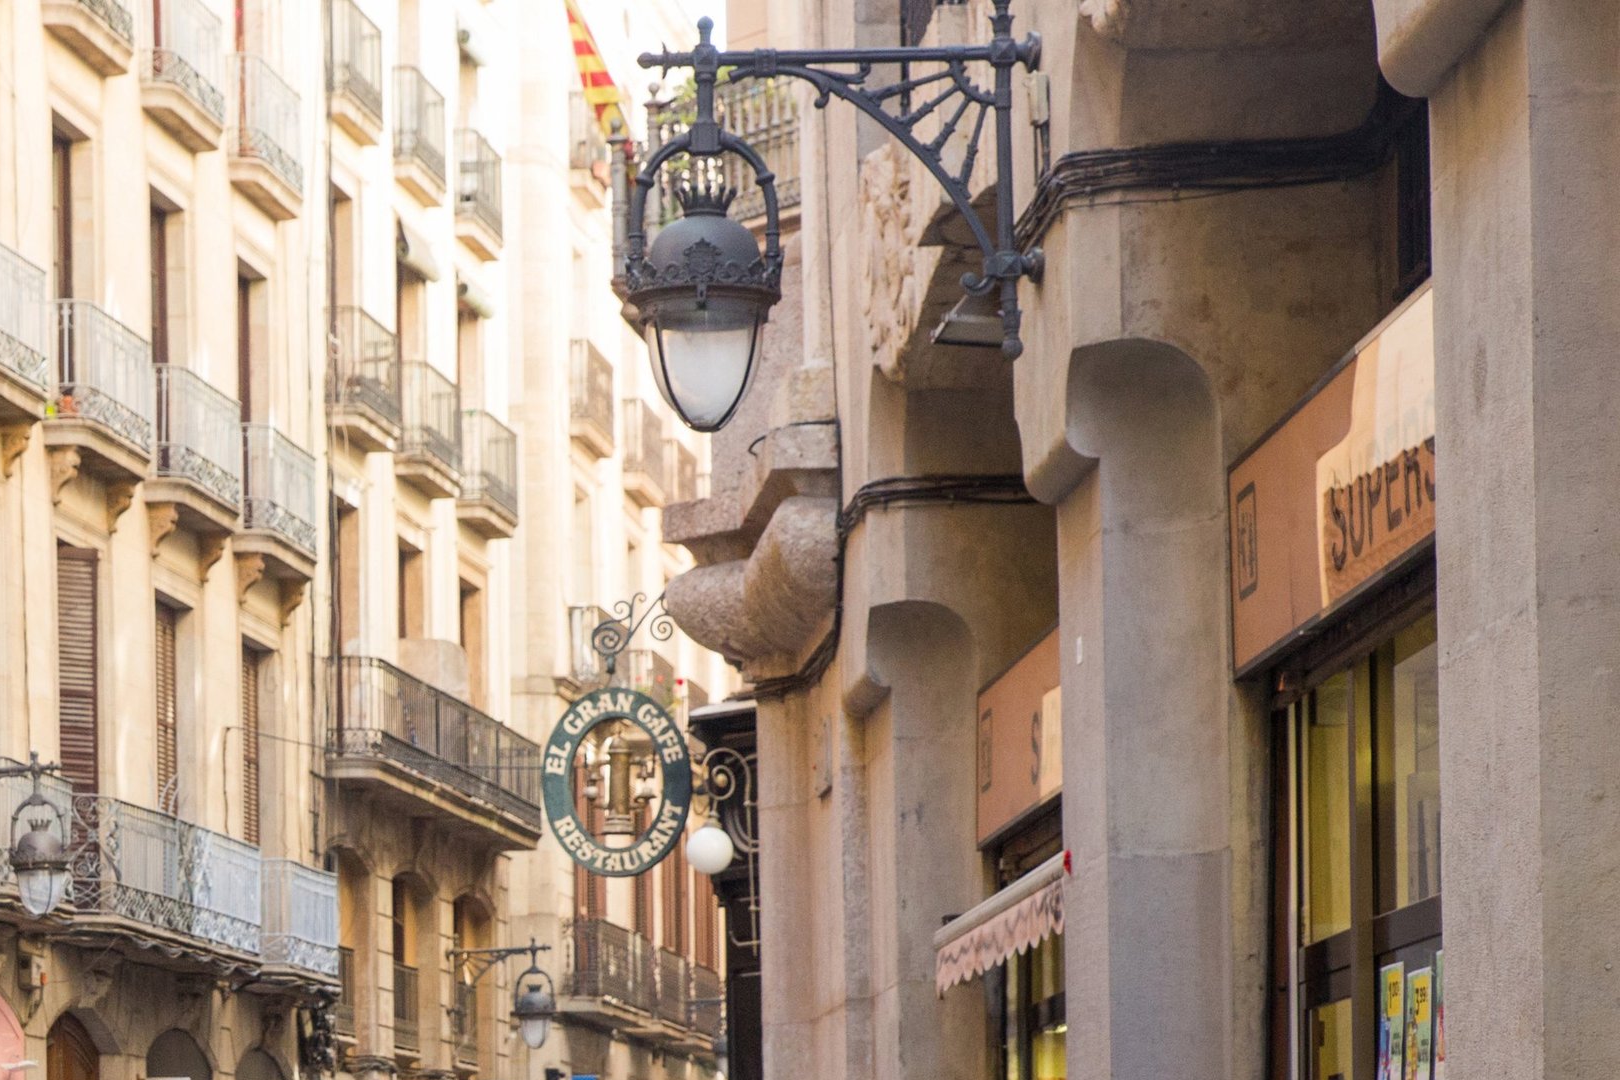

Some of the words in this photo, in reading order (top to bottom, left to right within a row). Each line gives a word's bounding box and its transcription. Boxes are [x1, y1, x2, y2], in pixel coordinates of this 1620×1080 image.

[545, 741, 571, 776] EL
[563, 692, 635, 735] GRAN
[553, 799, 683, 872] RESTAURANT
